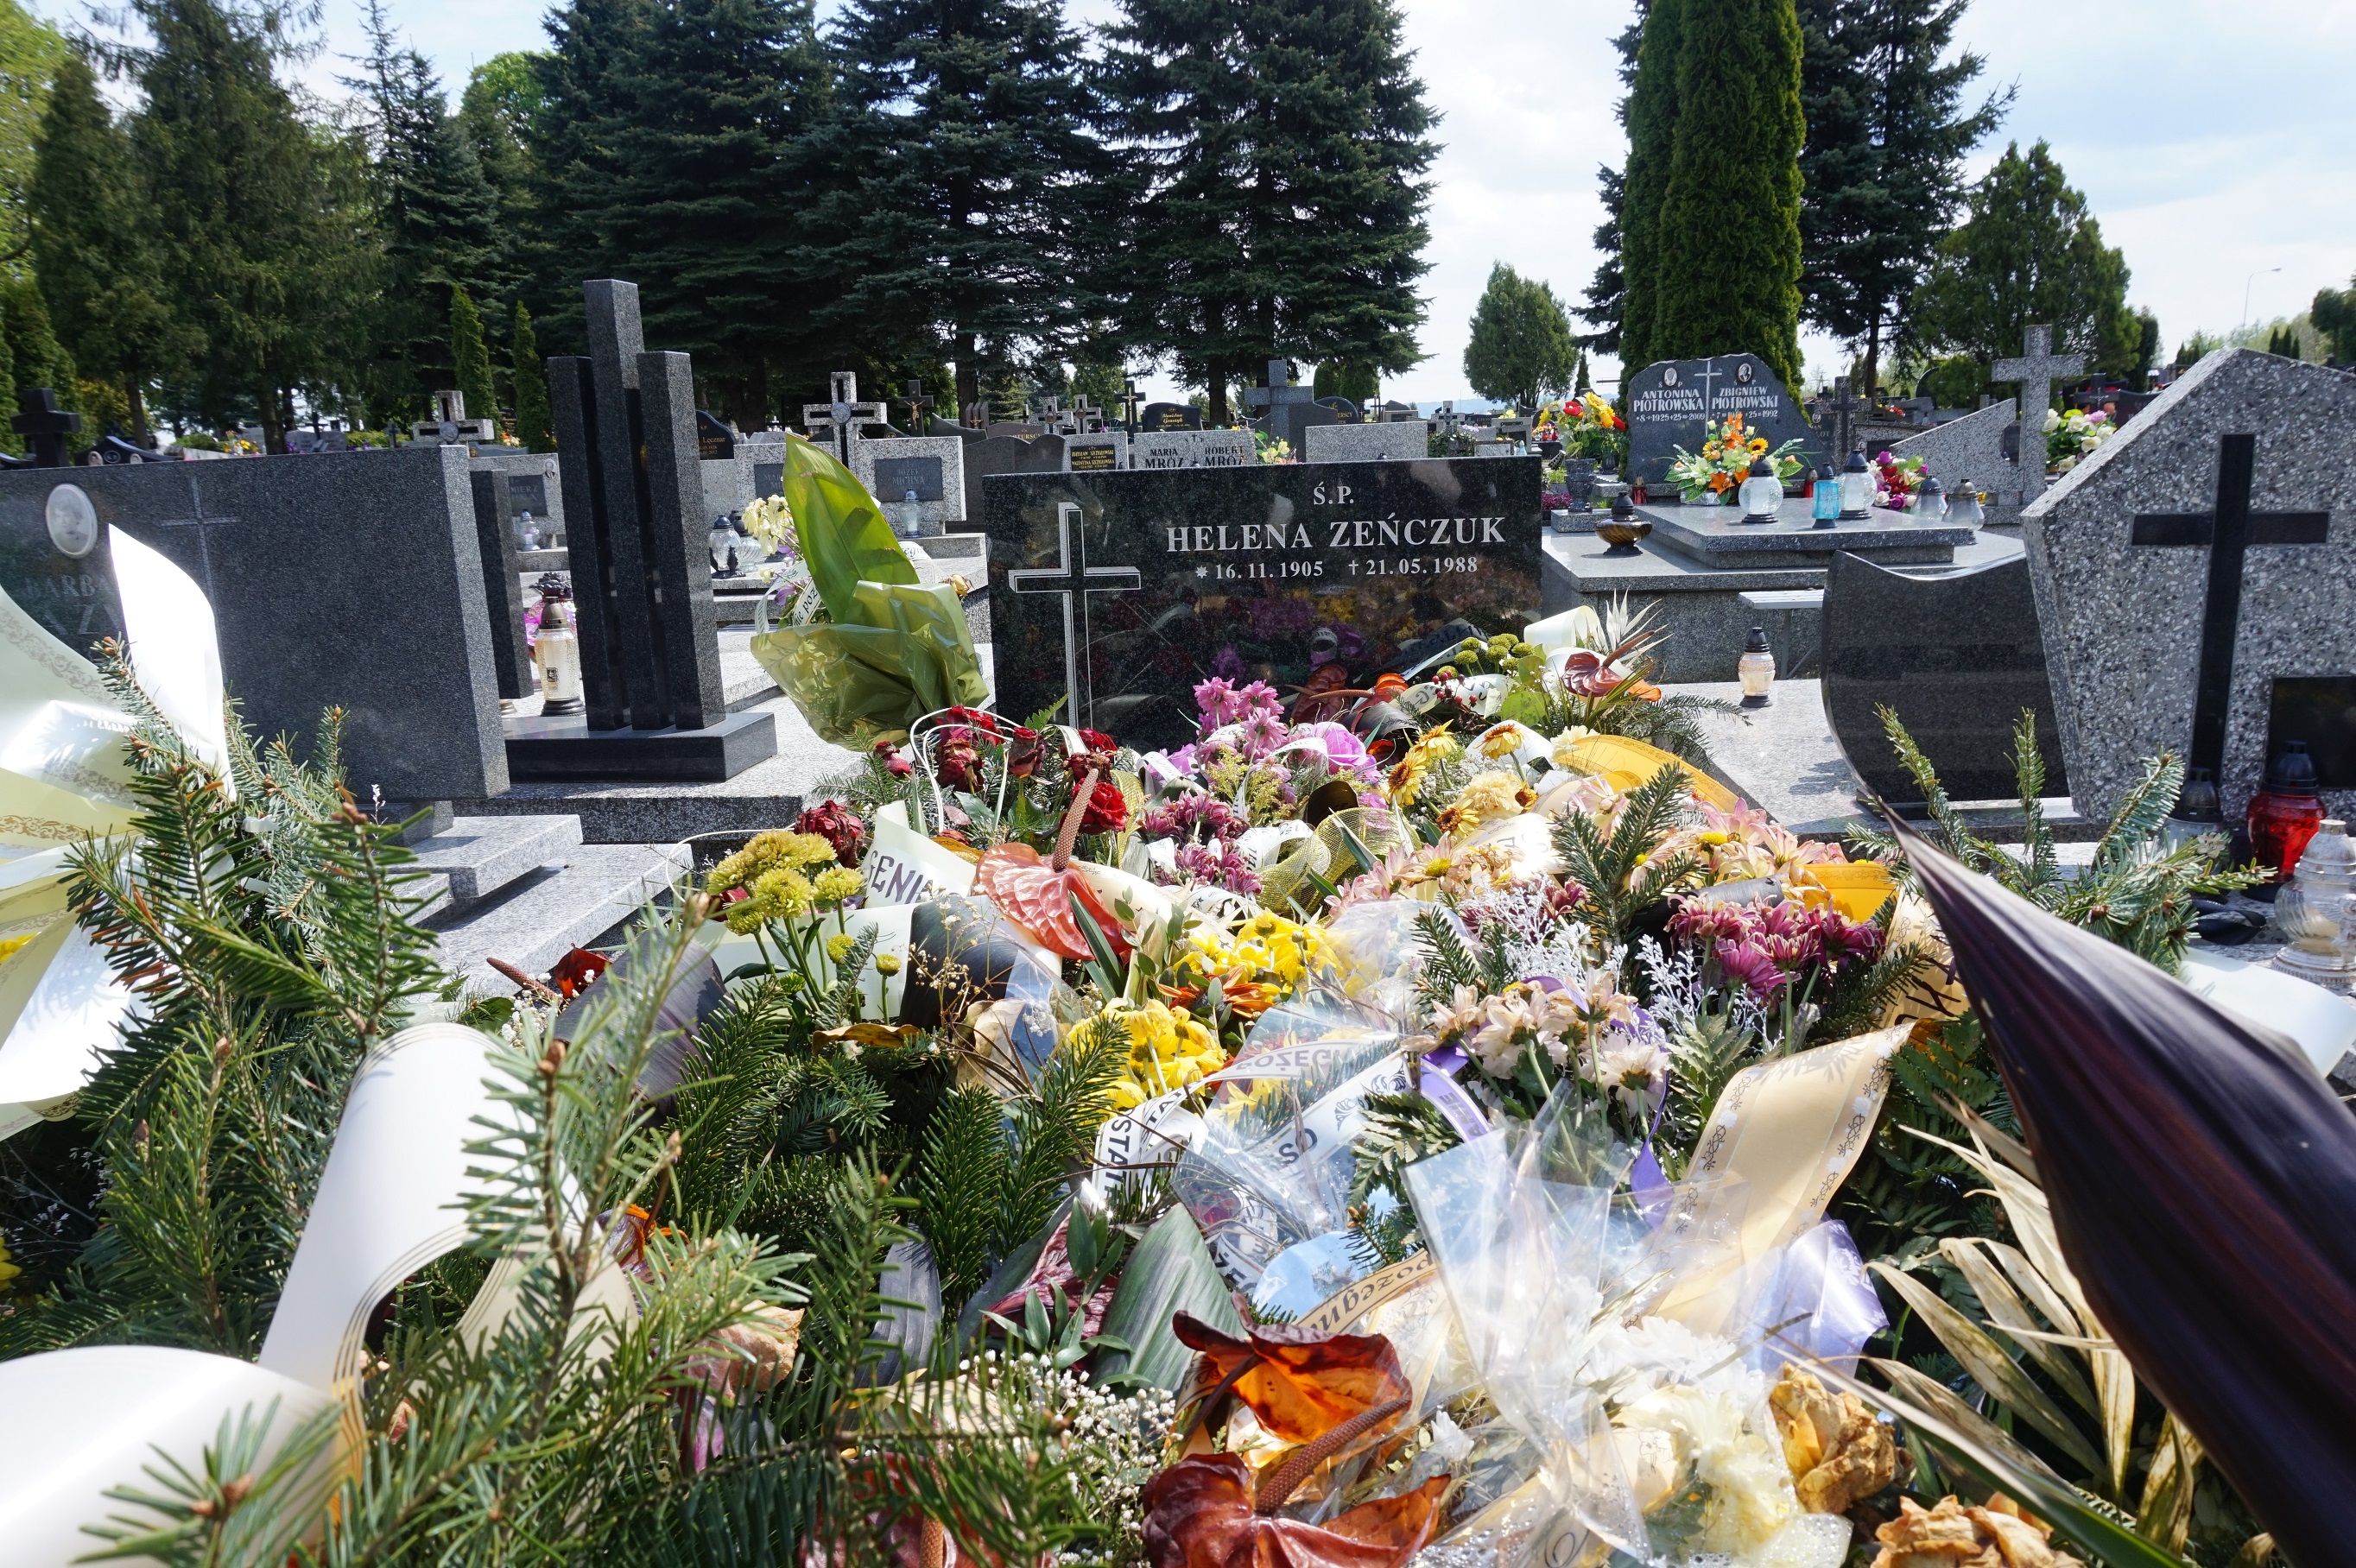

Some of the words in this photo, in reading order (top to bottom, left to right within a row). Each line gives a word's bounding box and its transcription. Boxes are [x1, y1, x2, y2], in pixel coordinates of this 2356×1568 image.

[1642, 389, 1700, 399] ANTONINA
[1720, 387, 1768, 396] ZBIGNIEW
[1633, 398, 1704, 412] PIOTROWSKA
[1712, 395, 1778, 409] PIOTROWSKI
[1206, 446, 1244, 455] ROBERT
[1166, 522, 1314, 553] HELENA
[1329, 512, 1506, 548] ZEŃCZUK
